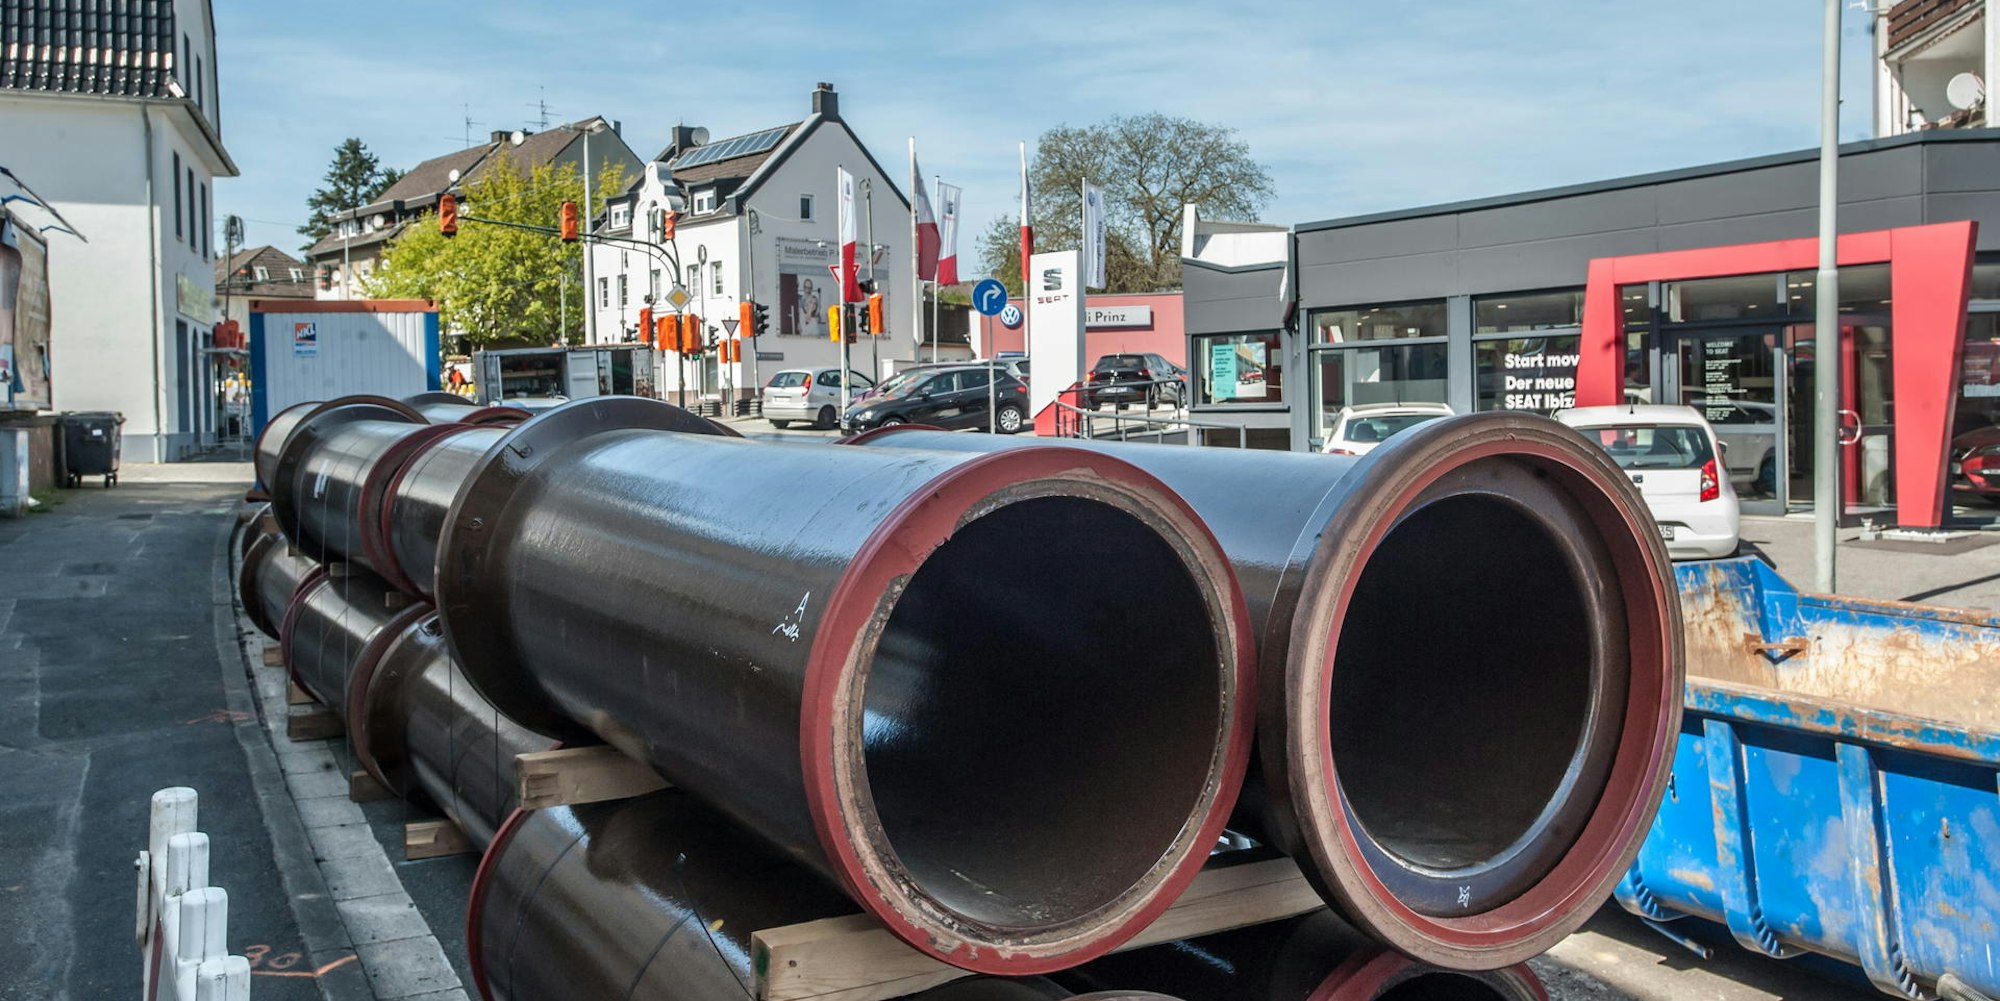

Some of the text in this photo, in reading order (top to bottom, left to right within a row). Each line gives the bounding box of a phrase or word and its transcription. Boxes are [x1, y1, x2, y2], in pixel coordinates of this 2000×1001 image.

[1037, 294, 1069, 304] SEAT
[1095, 311, 1126, 322] Prinz
[1504, 353, 1545, 369] Start
[1505, 375, 1575, 391] Der neue
[1505, 393, 1542, 410] SEAT
